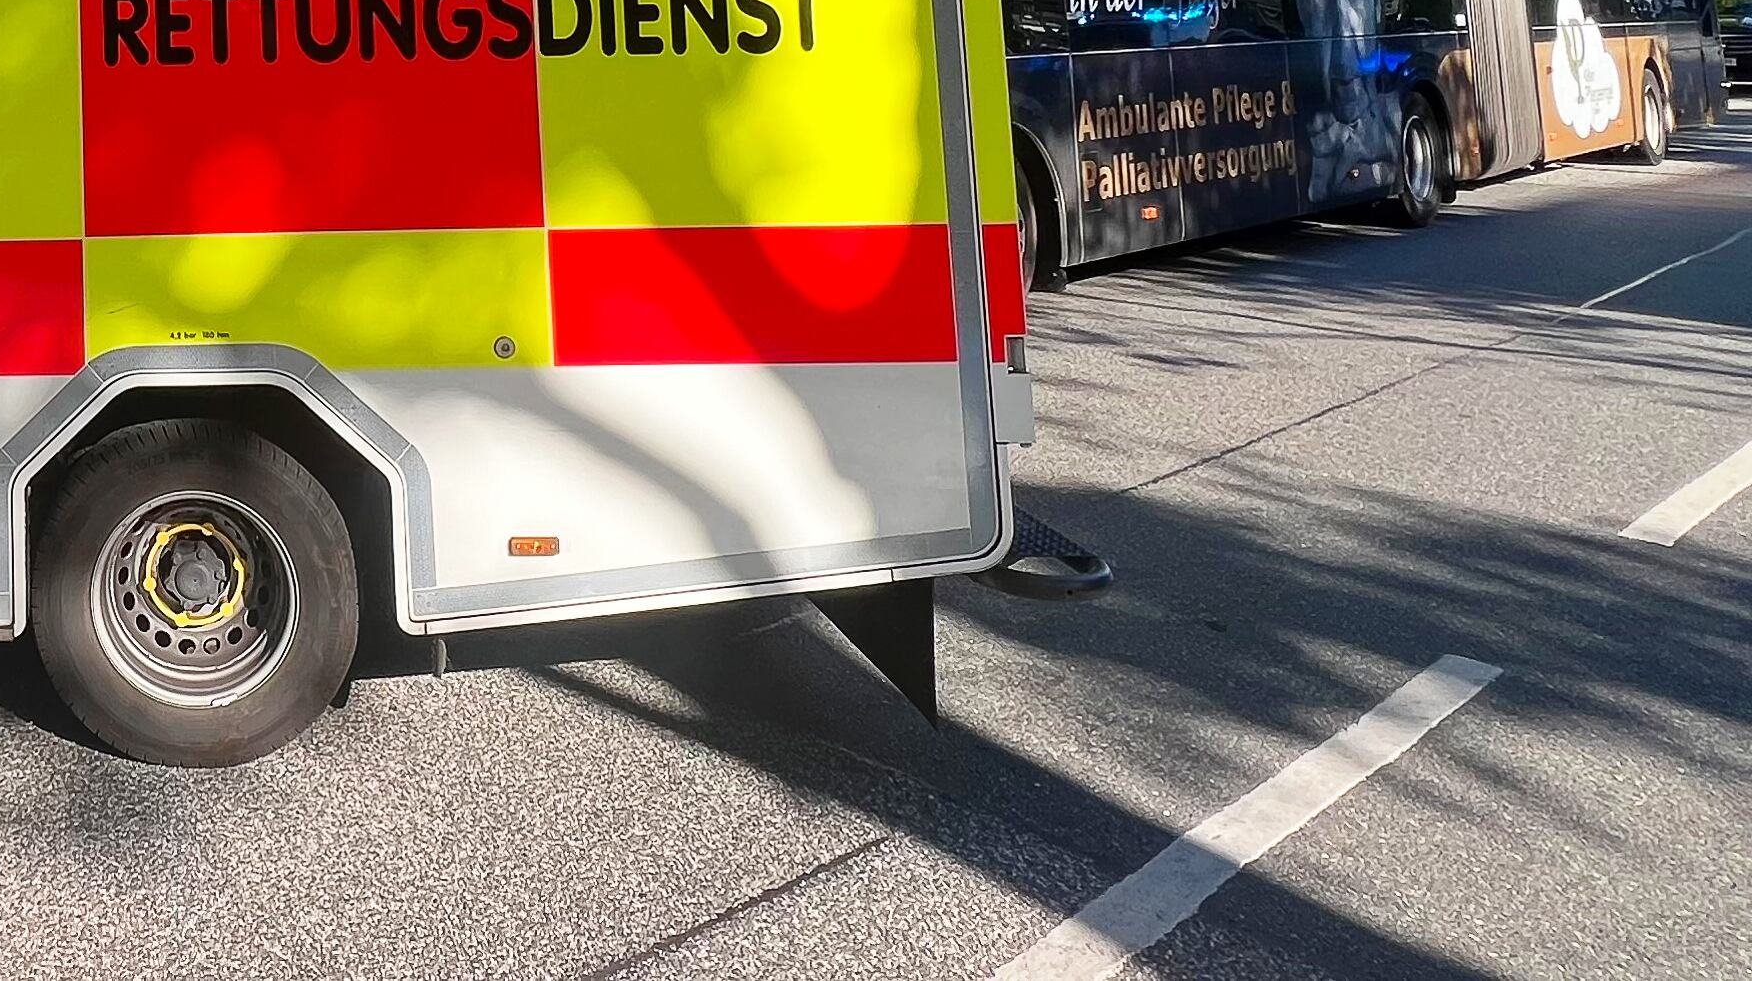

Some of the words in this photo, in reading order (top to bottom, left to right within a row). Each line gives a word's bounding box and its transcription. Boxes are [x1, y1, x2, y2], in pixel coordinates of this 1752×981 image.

[1078, 91, 1205, 143] Ambulante
[1212, 84, 1276, 129] Pflege
[1282, 80, 1297, 115] &
[1082, 138, 1298, 202] Palliativversorgung
